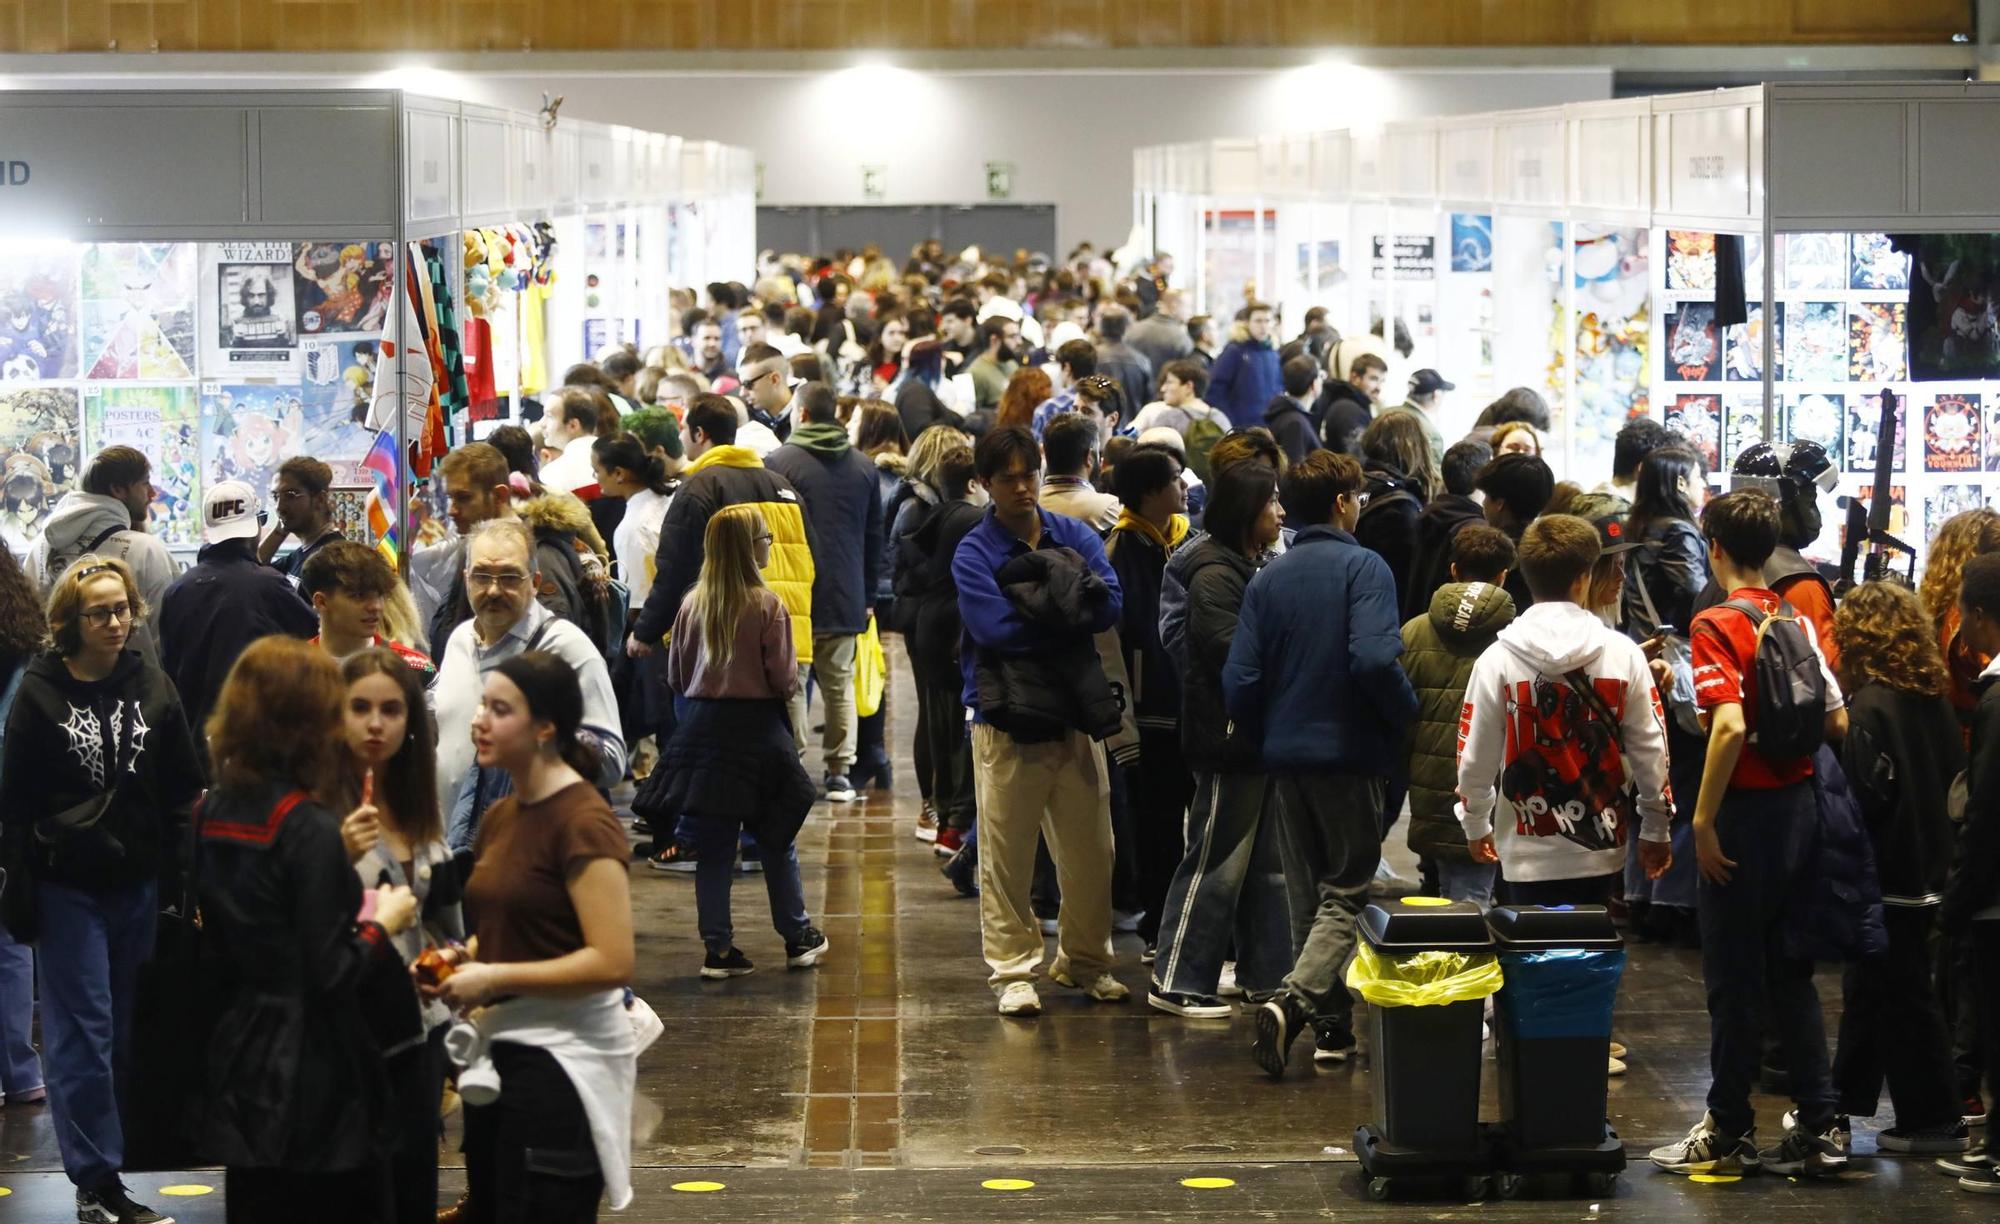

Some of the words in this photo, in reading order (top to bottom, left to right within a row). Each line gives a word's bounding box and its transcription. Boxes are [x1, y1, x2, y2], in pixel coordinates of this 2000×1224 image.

[105, 410, 161, 422] POSTERS
[212, 499, 245, 519] UFC
[1452, 599, 1475, 632] JEANS
[1512, 796, 1548, 826] HO
[1551, 799, 1586, 834] HO
[1592, 807, 1618, 842] HO
